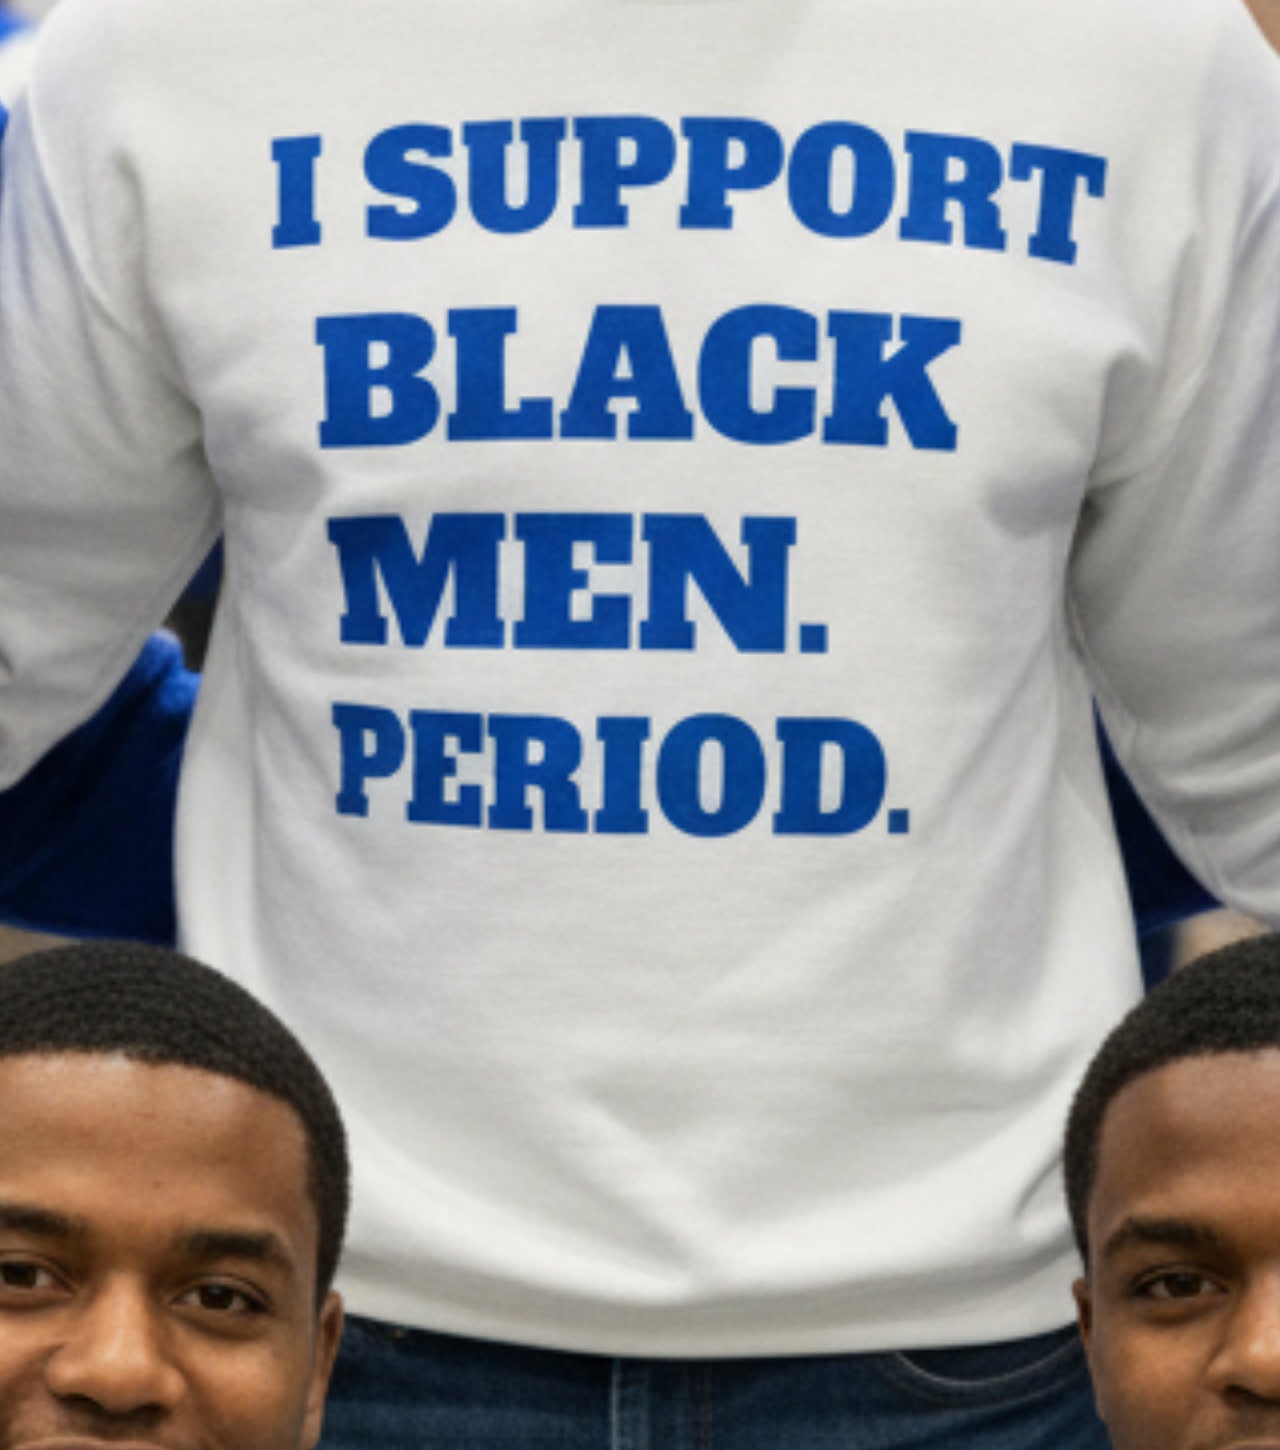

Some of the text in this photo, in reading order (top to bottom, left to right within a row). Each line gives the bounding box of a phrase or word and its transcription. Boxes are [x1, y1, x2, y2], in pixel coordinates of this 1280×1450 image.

[270, 114, 1109, 266] I SUPPORT
[314, 303, 963, 453] BLACK
[326, 511, 829, 655] MEN.
[330, 700, 911, 839] PERIOD.
